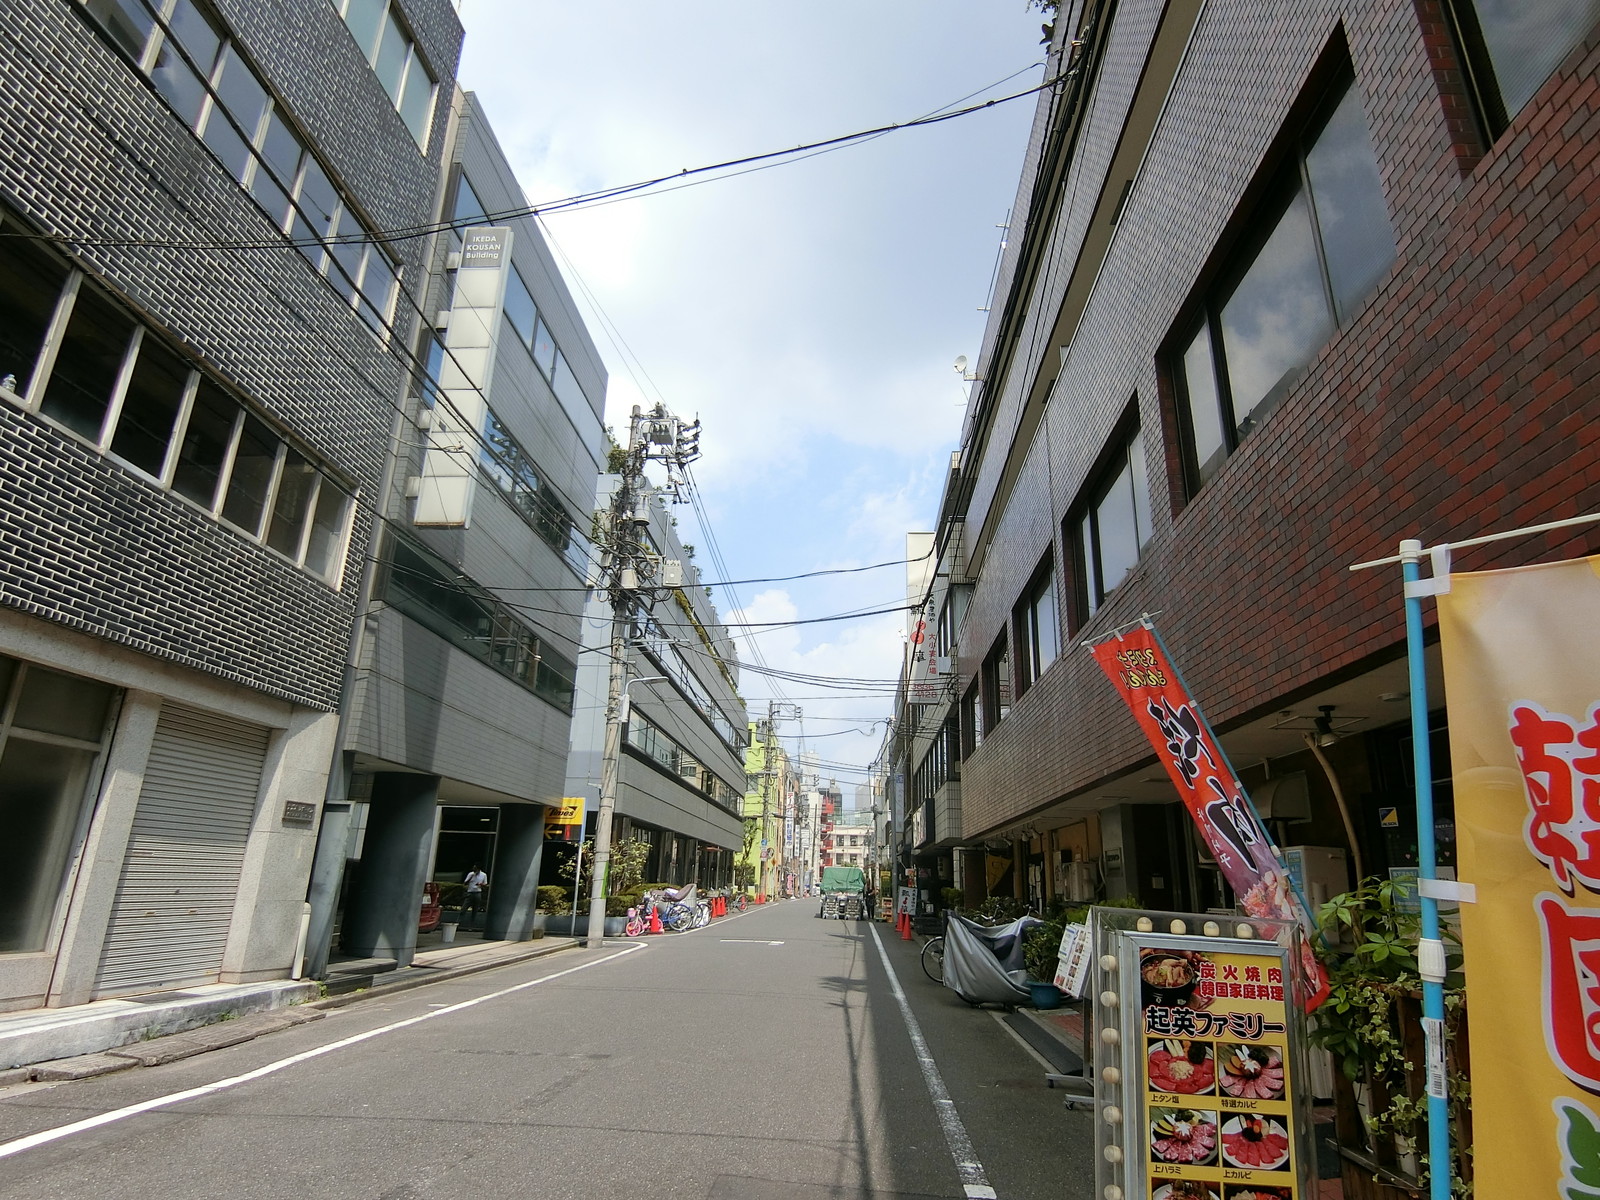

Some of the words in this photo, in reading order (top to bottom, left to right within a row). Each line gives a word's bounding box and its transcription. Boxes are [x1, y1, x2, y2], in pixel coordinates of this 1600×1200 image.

[1200, 962, 1282, 983] 炭火焼肉
[1201, 980, 1284, 1001] 韓国家庭料理
[1146, 1005, 1285, 1039] 起英ファミリー
[1151, 1094, 1180, 1104] 上タン塩
[1221, 1099, 1258, 1109] 特選カルビ
[1153, 1164, 1182, 1174] 上ハラミ
[1223, 1170, 1252, 1179] 上カルビ
